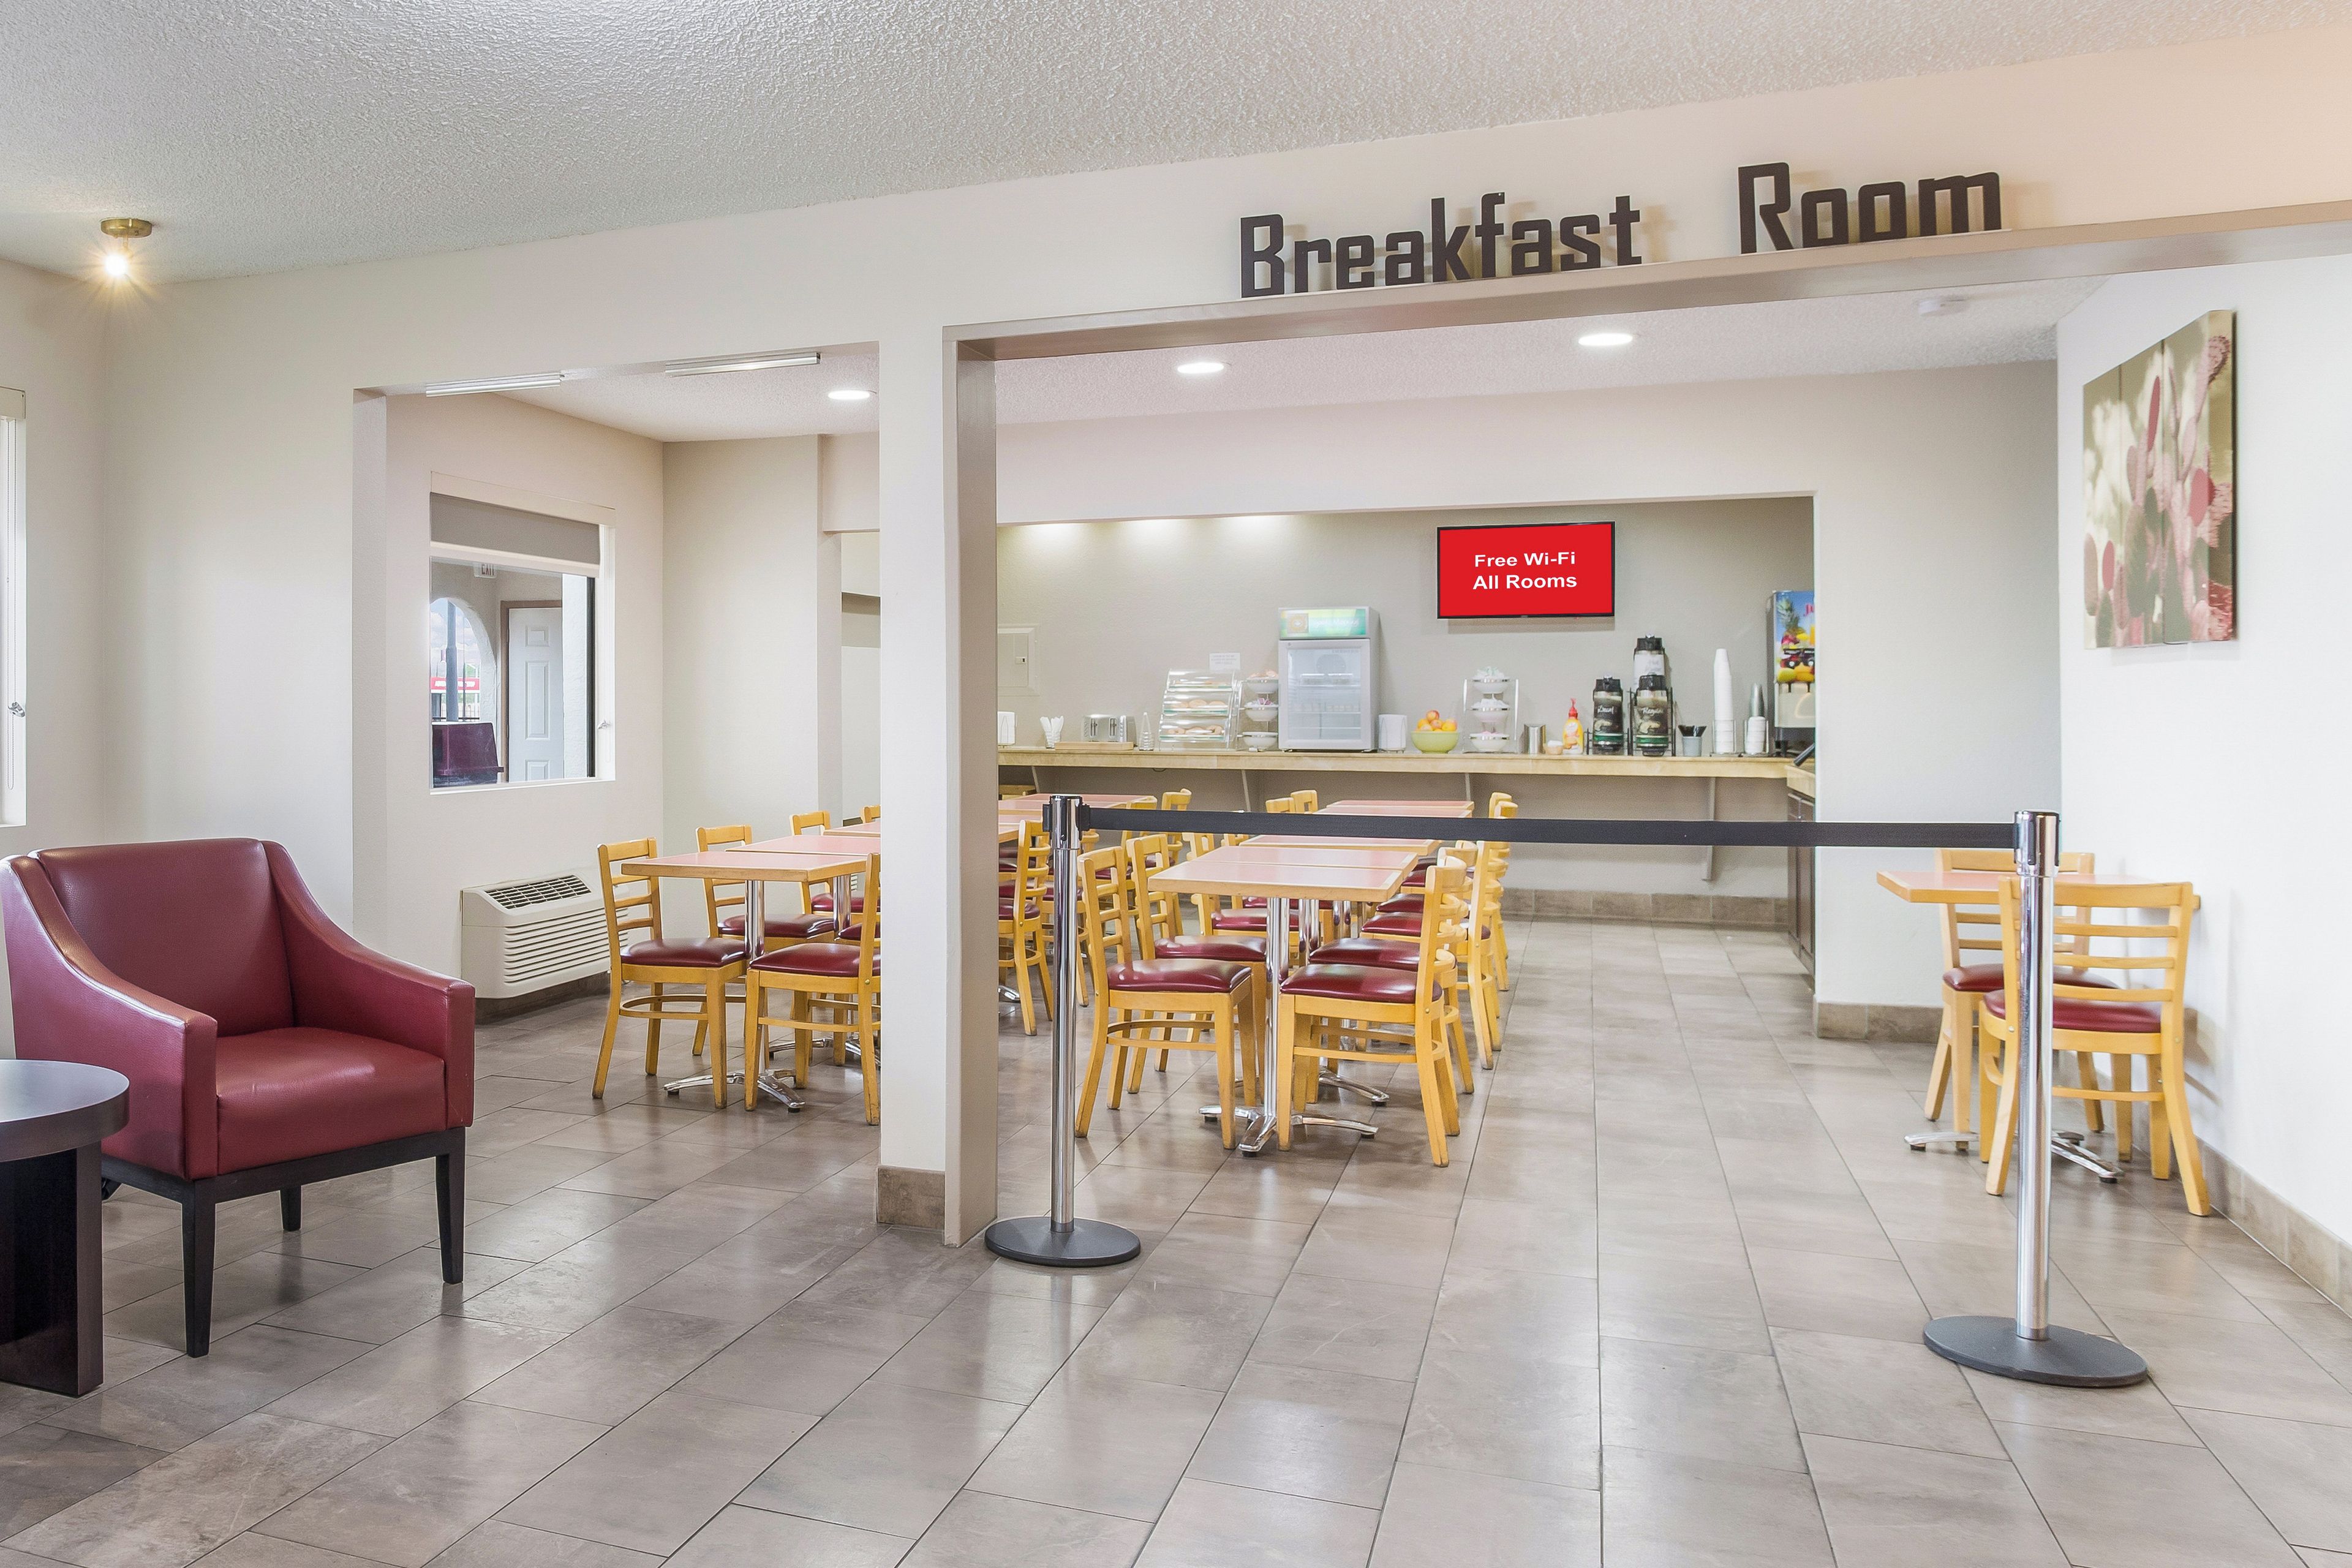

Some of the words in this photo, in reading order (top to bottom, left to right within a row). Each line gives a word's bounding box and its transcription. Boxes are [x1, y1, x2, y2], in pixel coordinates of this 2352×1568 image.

[1240, 192, 1642, 298] Breakfast
[1738, 162, 2002, 254] Room
[1475, 554, 1518, 567] Free
[1523, 552, 1575, 565] Wi-Fi
[1472, 575, 1499, 590] All
[1506, 575, 1577, 589] Rooms
